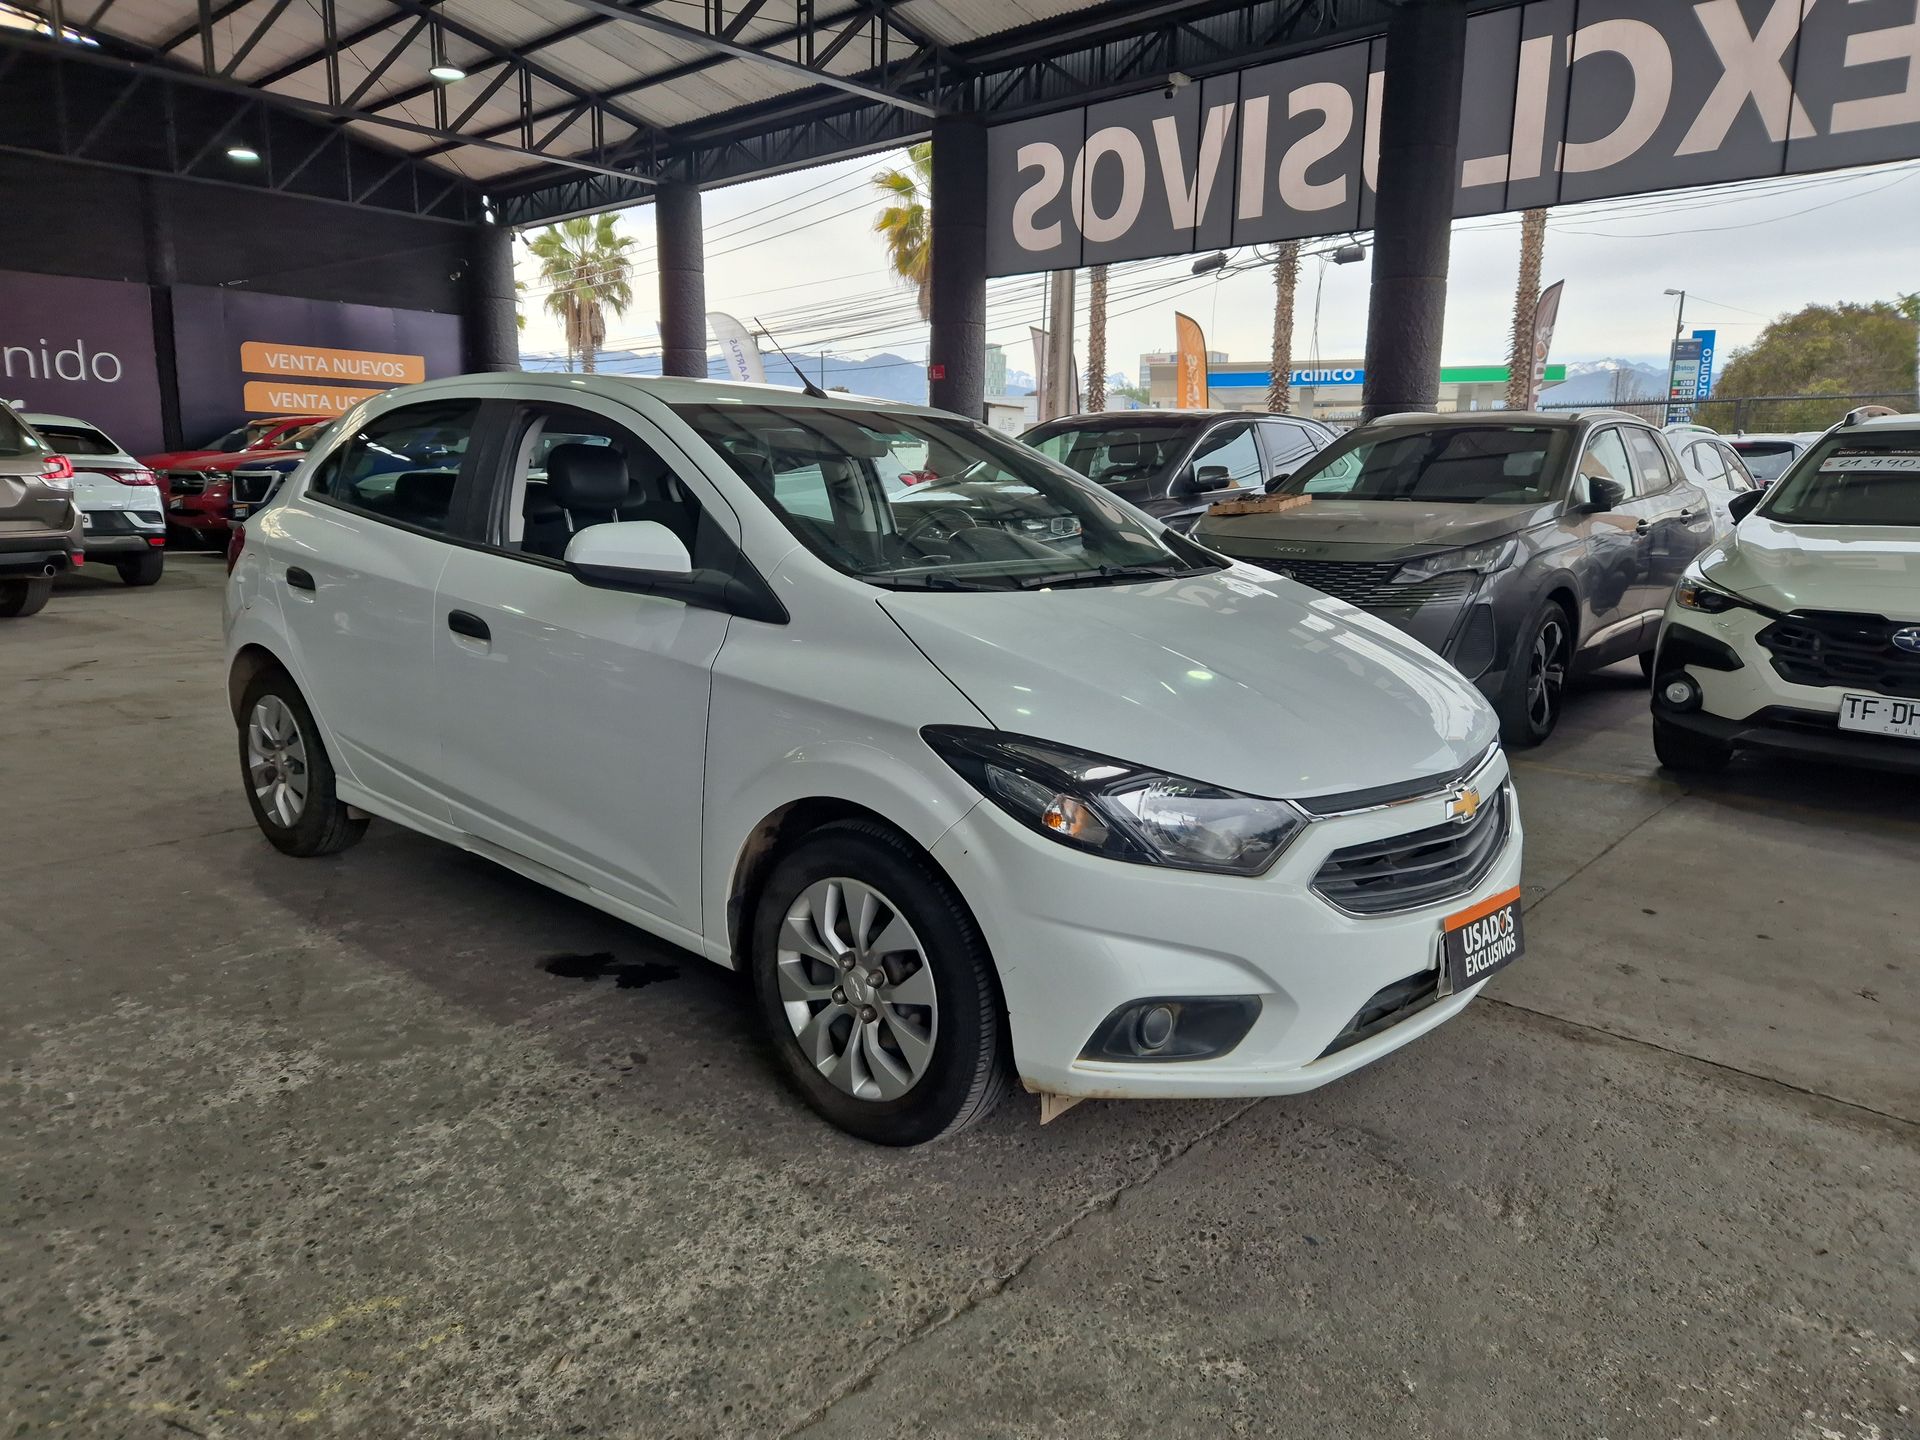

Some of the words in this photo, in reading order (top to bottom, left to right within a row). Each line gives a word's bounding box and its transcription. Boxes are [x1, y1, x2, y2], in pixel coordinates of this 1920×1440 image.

[3, 338, 122, 383] nido
[265, 352, 329, 373] VENTA
[333, 358, 405, 378] NUEVOS
[1288, 368, 1356, 382] ramco
[268, 391, 332, 411] VENTA
[1462, 905, 1514, 955] USADOS
[1465, 932, 1516, 977] EXCLUSIVOS
